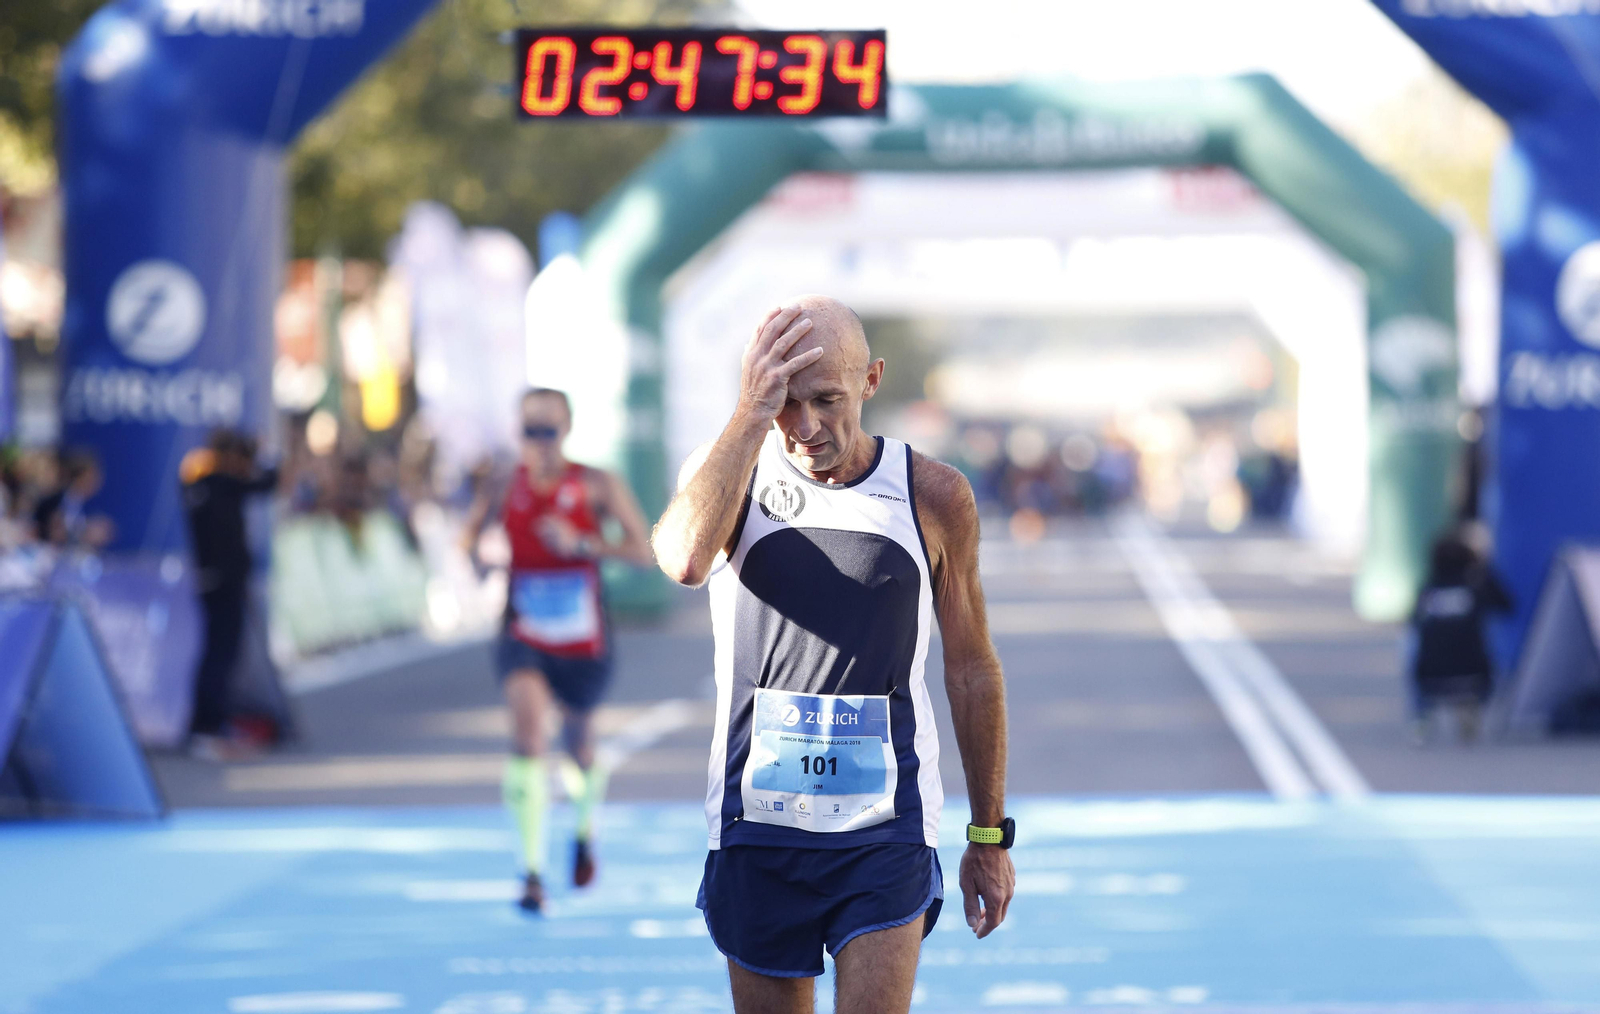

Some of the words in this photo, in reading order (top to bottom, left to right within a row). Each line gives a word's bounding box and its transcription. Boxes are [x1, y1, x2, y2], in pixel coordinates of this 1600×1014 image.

[521, 35, 885, 116] 02:47:34
[804, 711, 858, 725] ZURICH
[800, 755, 837, 776] 101
